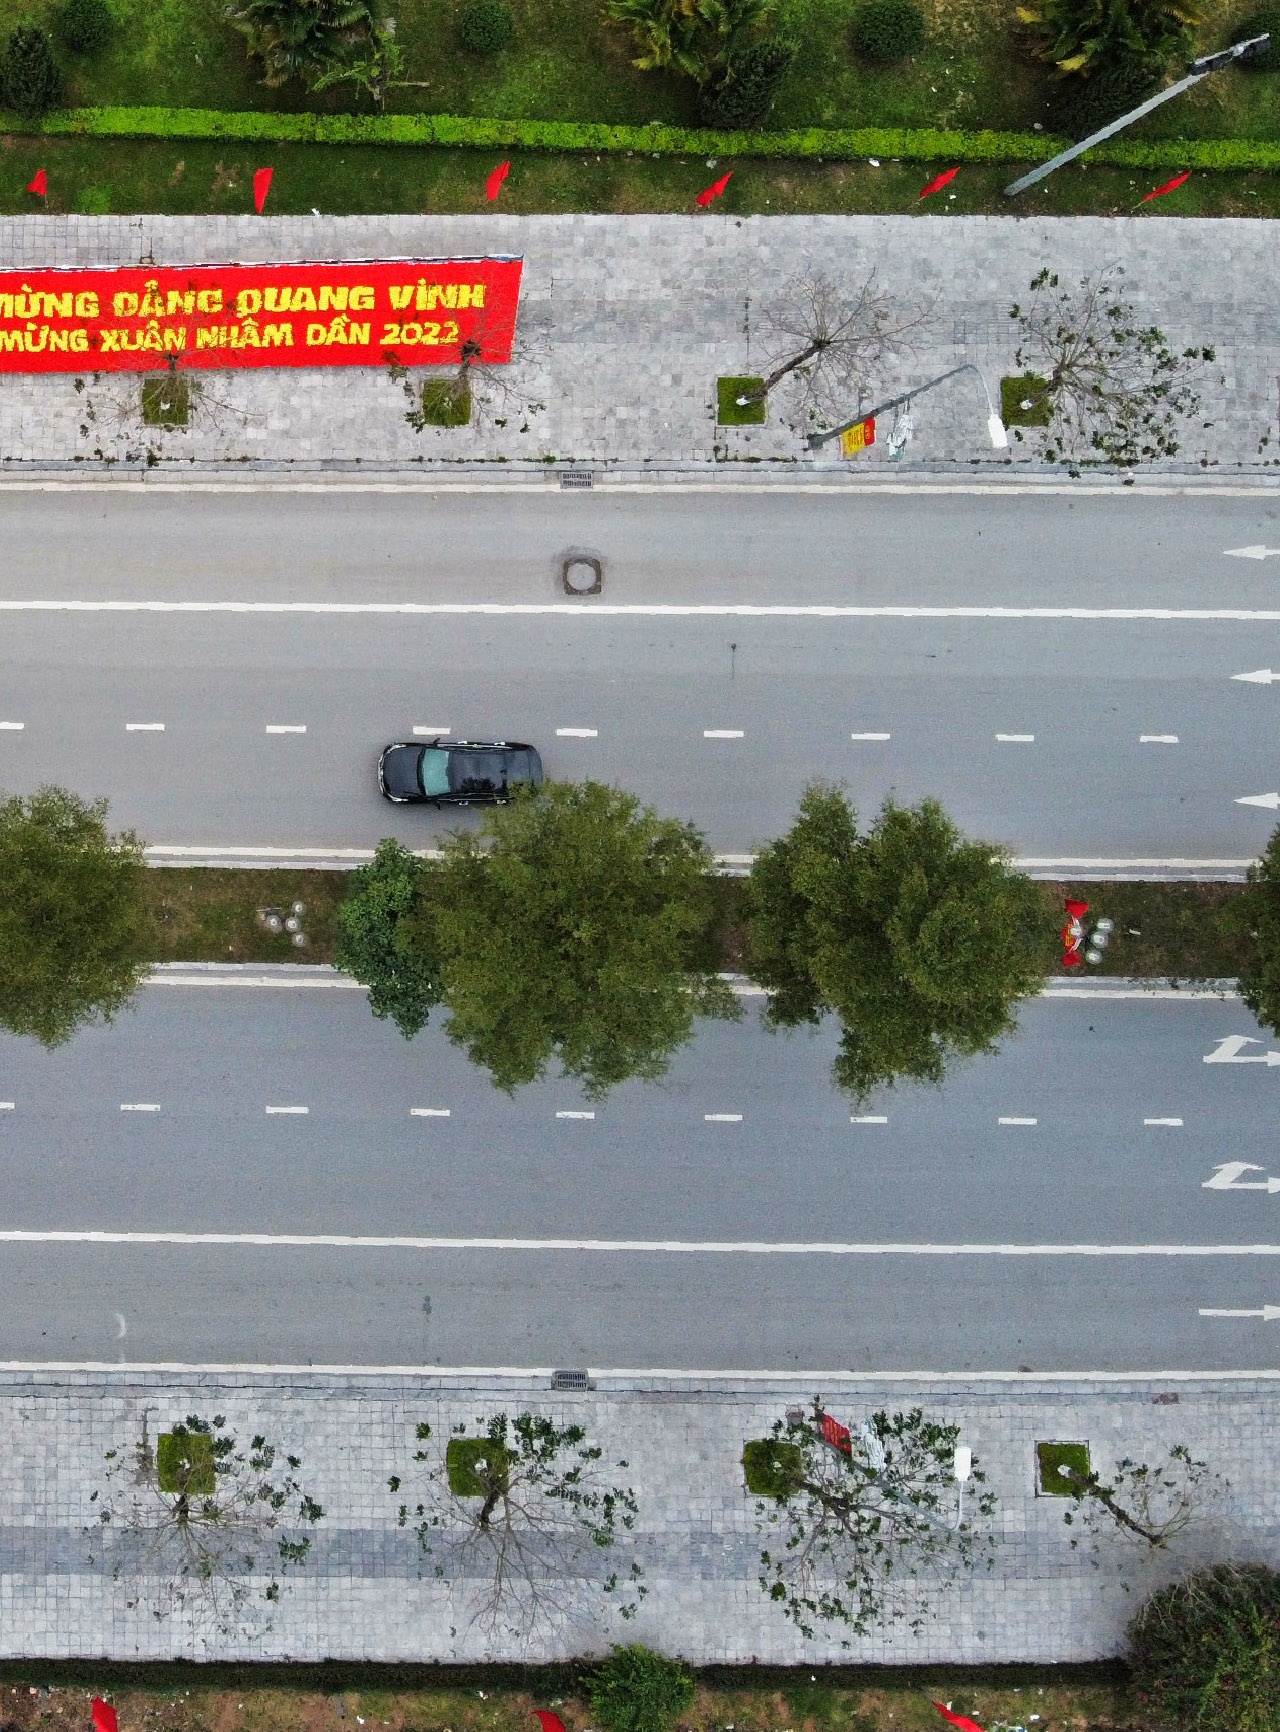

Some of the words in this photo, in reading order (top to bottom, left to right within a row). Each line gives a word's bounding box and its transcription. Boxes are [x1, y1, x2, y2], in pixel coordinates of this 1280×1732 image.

[236, 286, 376, 318] QUANG
[100, 319, 187, 352] XUÂN
[196, 317, 295, 350] NHÂM
[306, 312, 372, 347] DẦN
[379, 320, 460, 345] 2022
